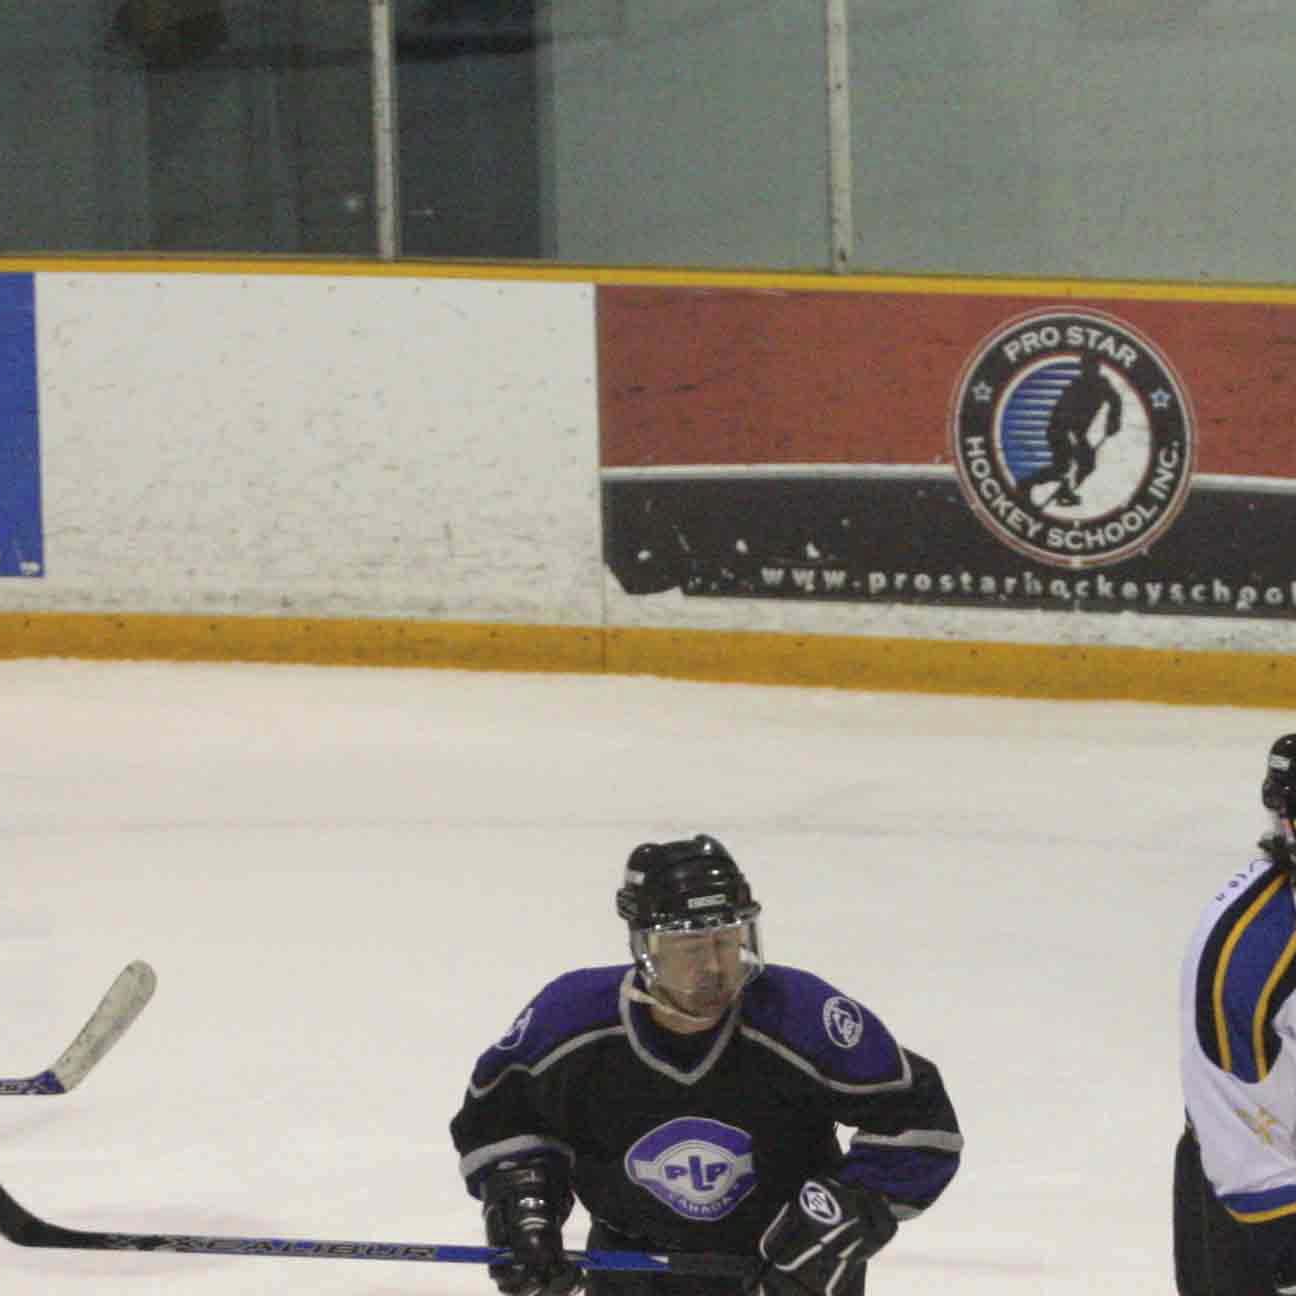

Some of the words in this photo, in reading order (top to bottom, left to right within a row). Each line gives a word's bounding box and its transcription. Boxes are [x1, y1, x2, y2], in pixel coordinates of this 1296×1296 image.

[1003, 325, 1061, 364] PRO
[1066, 324, 1139, 368] STAR
[965, 435, 1044, 539] HOCKEY
[1046, 503, 1159, 550] SCHOOL
[1148, 439, 1181, 500] INC.
